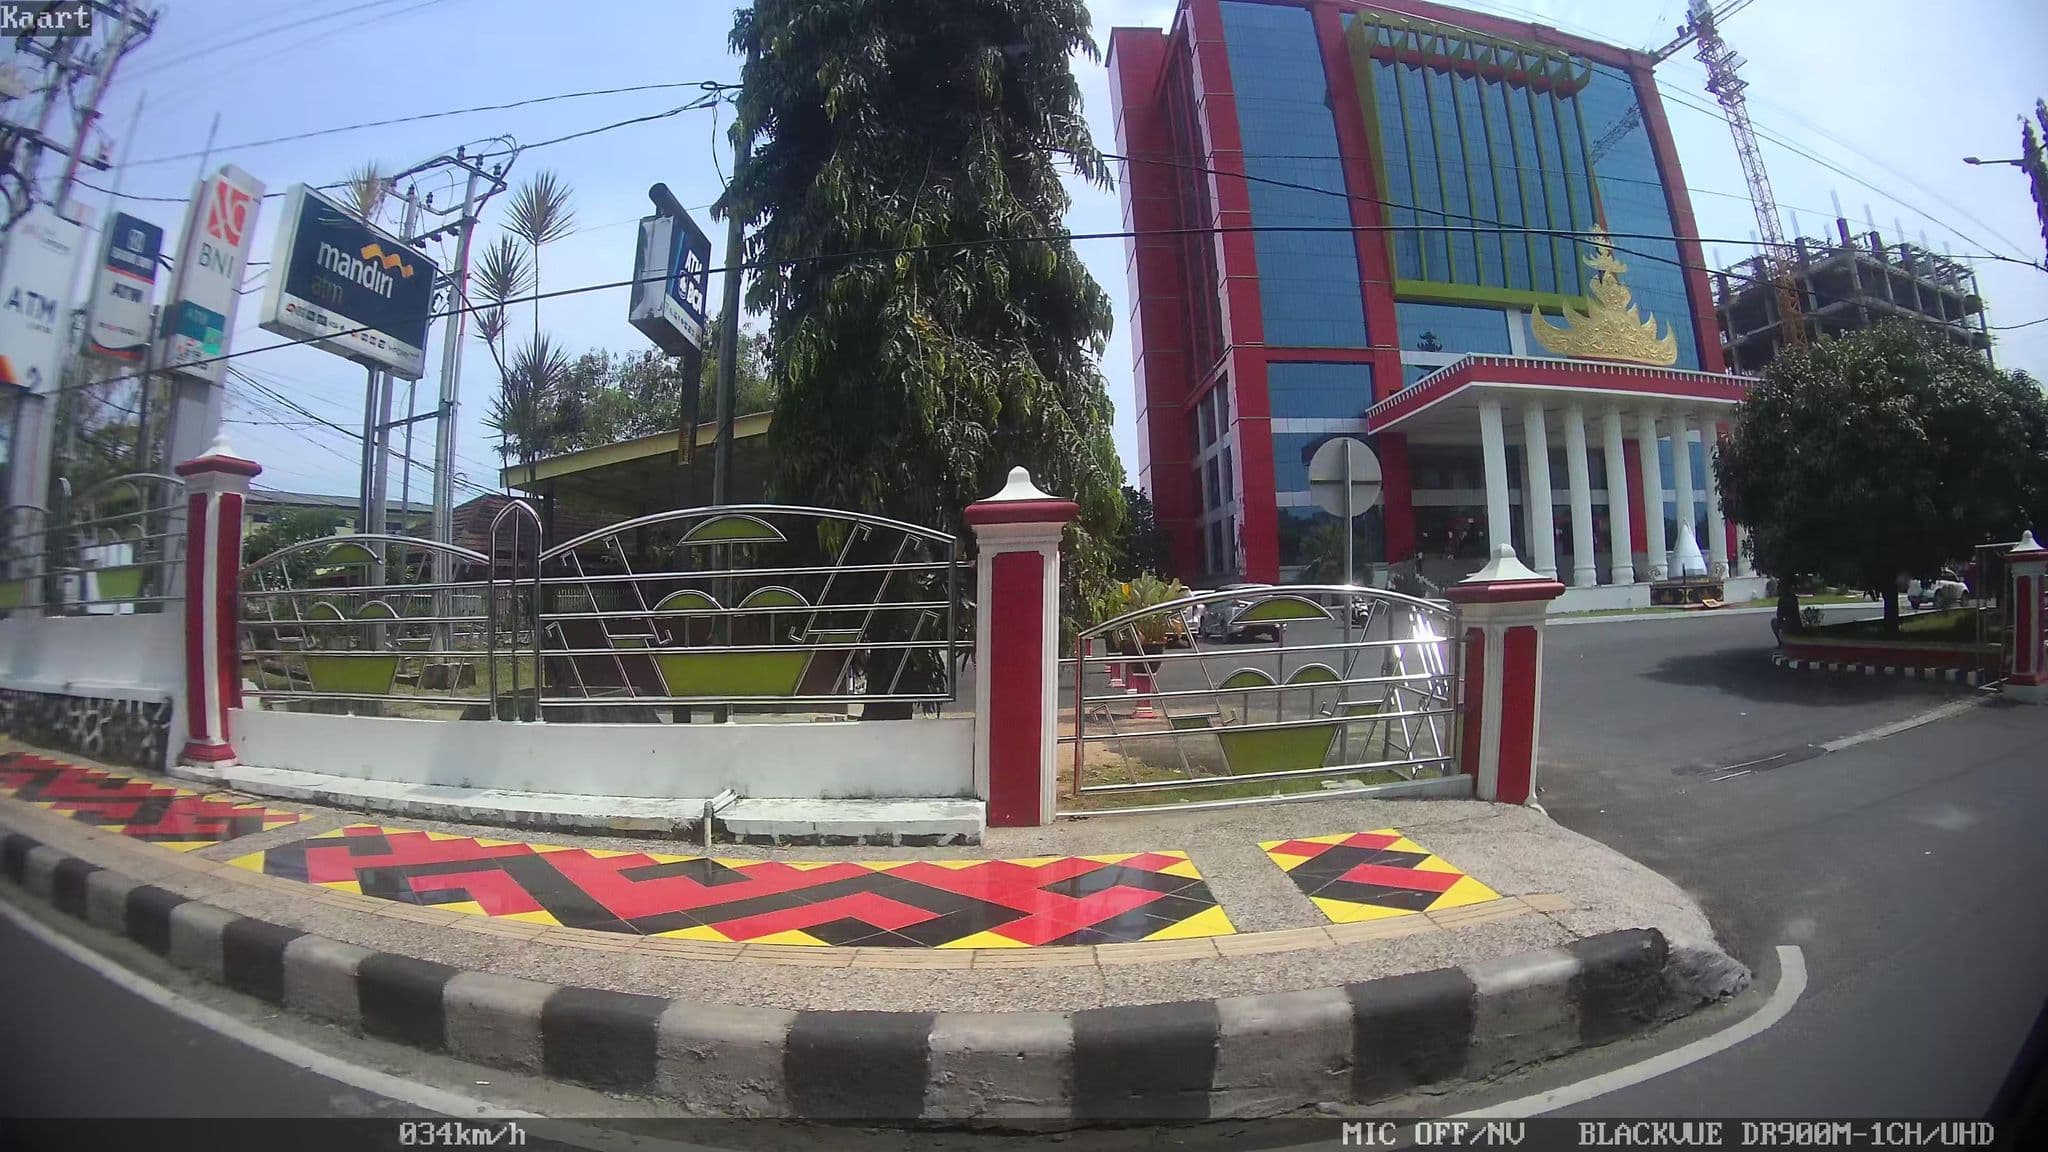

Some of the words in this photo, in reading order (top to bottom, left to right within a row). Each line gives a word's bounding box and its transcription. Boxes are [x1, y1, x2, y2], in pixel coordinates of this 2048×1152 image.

[199, 242, 234, 280] BNI
[317, 240, 394, 299] mandiri
[685, 249, 702, 284] ATM
[3, 286, 59, 324] ATM
[311, 274, 345, 305] atm
[687, 281, 703, 315] BCA
